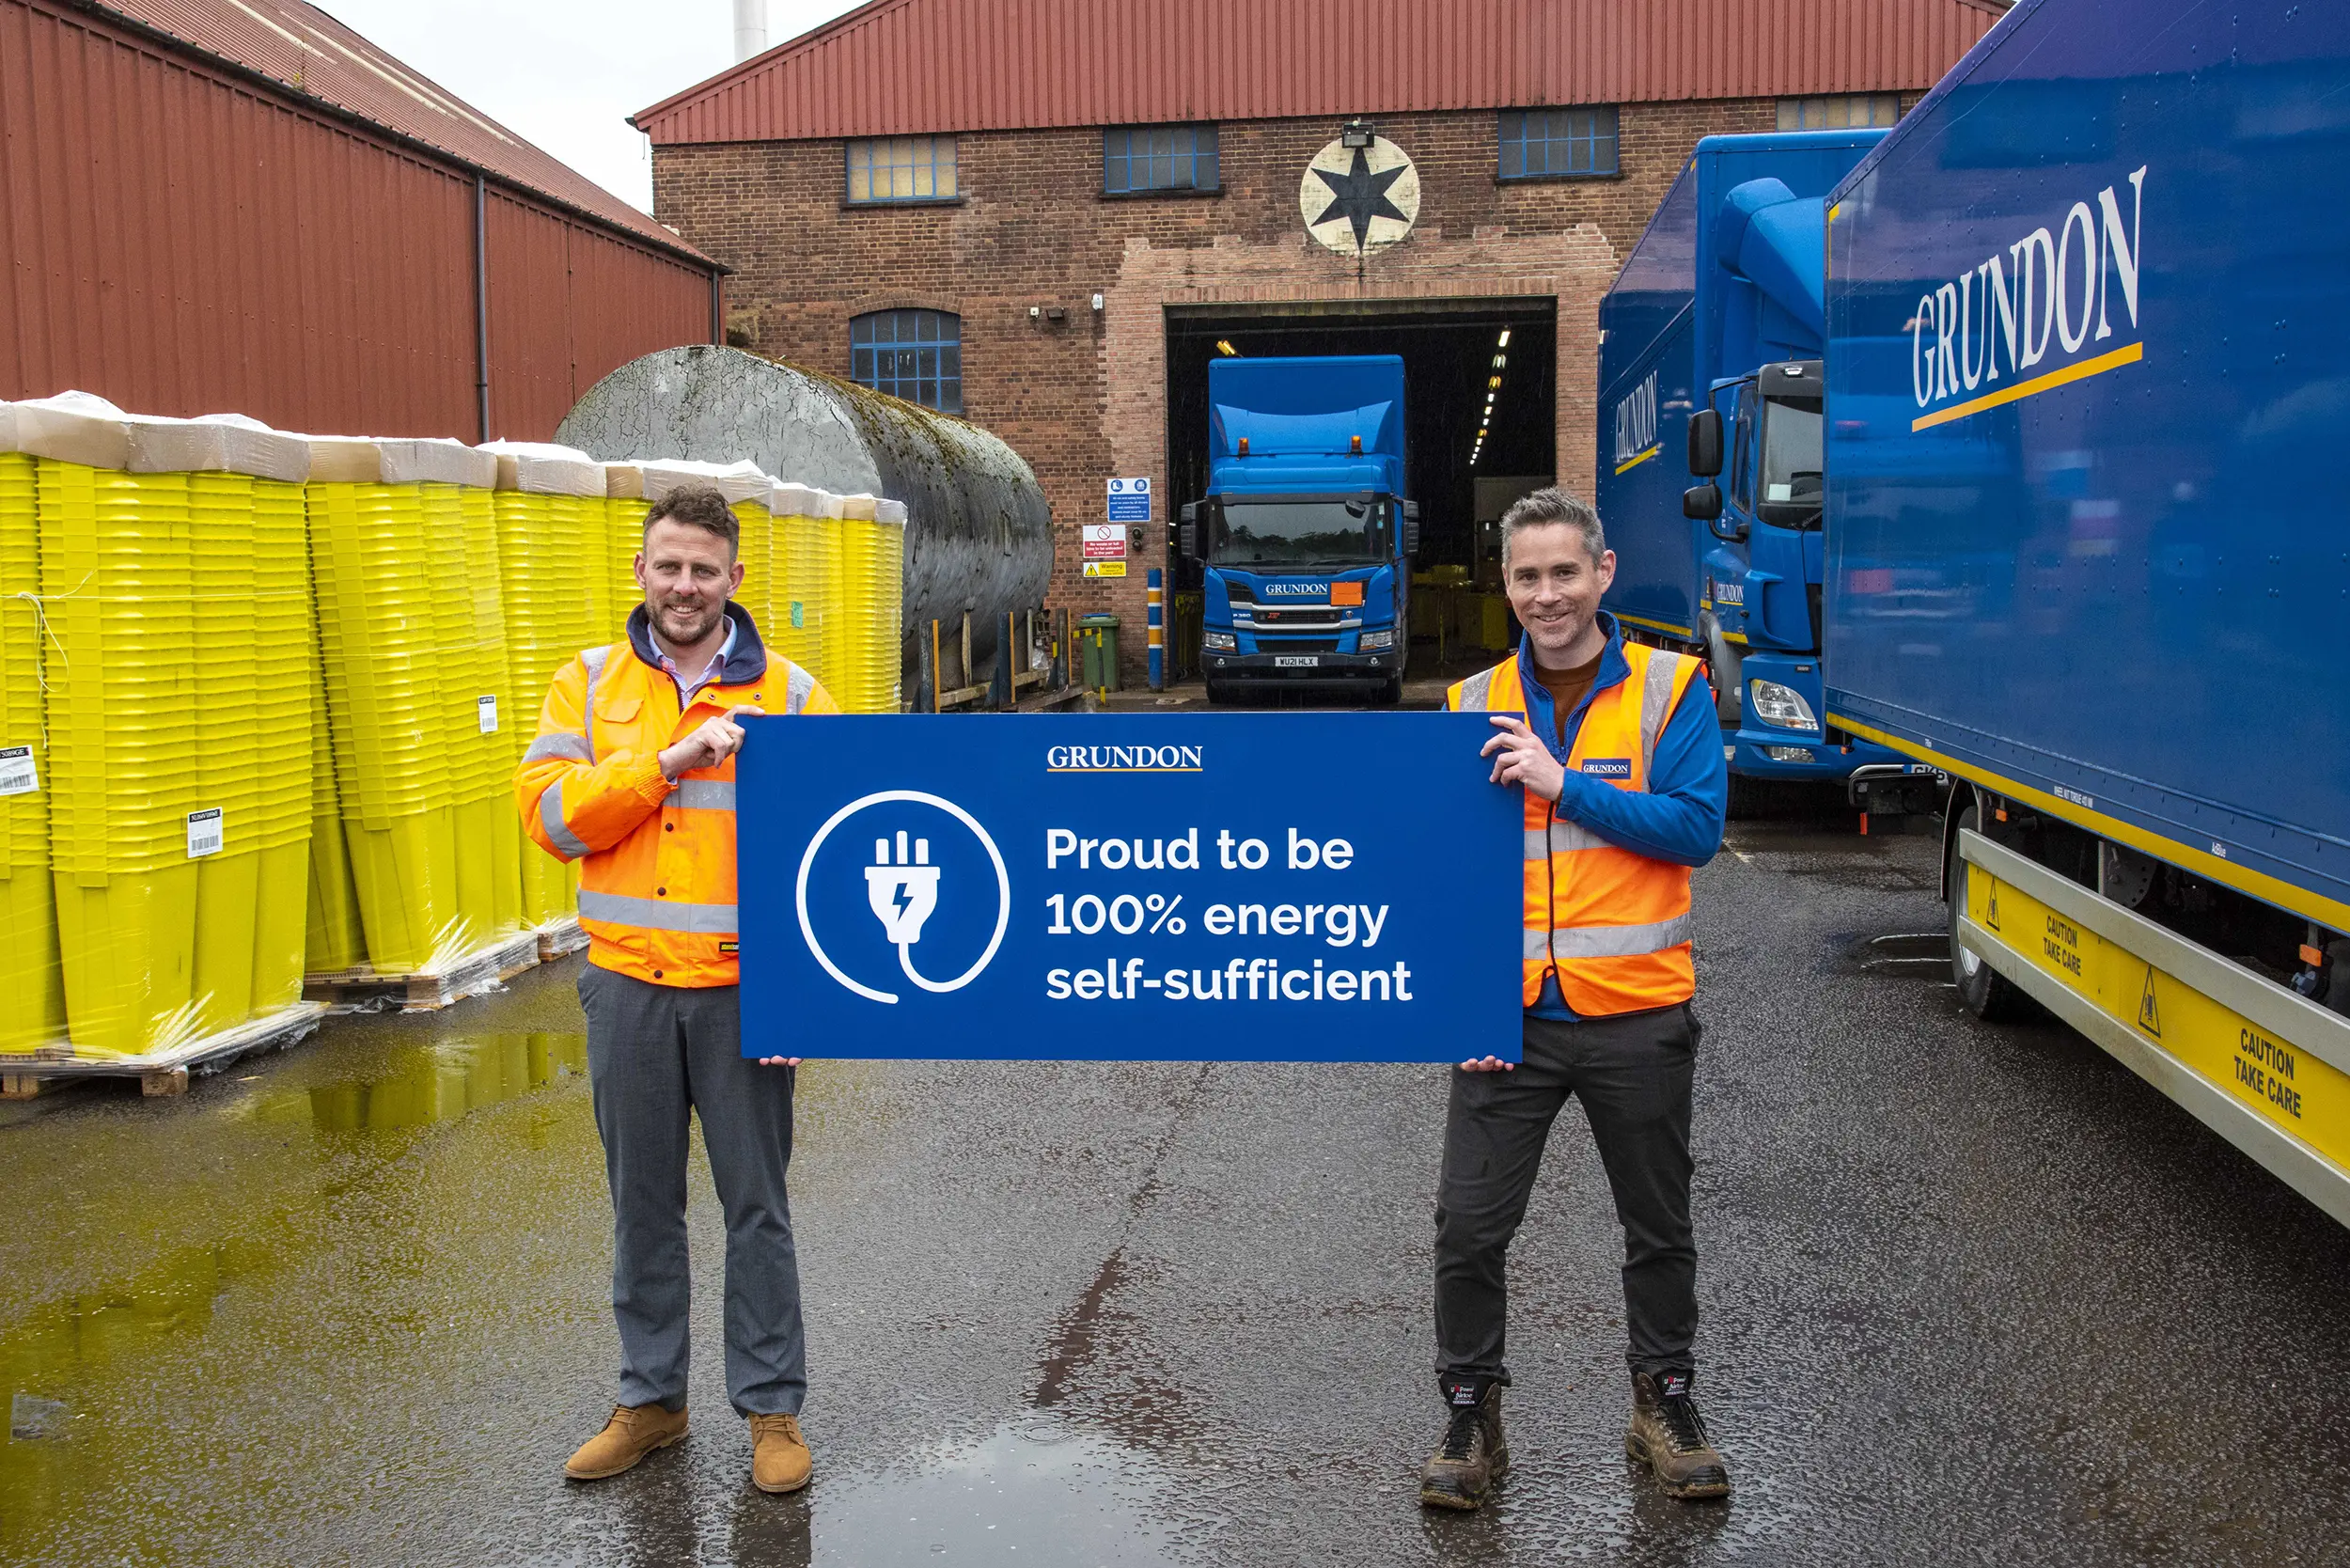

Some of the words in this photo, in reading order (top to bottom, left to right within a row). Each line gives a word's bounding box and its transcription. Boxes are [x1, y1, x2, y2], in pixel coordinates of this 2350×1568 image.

[1913, 165, 2147, 408] GRUNDON
[1615, 369, 1657, 462] GRUNDON
[1265, 584, 1328, 593] GRUNDON
[1716, 583, 1744, 602] GRUNDON
[1047, 745, 1203, 768] GRUNDON
[1046, 827, 1199, 870] Proud
[1216, 829, 1269, 870] to
[1288, 827, 1354, 870] be
[1045, 894, 1186, 935] 100%
[1203, 902, 1389, 948] energy
[2046, 915, 2077, 949] CAUTION
[2044, 936, 2060, 964] TAKE
[2061, 949, 2081, 977] CARE
[1046, 958, 1414, 1001] self-sufficient
[2240, 1027, 2294, 1081] CAUTION
[2233, 1055, 2264, 1096] TAKE
[2267, 1076, 2301, 1120] CARE
